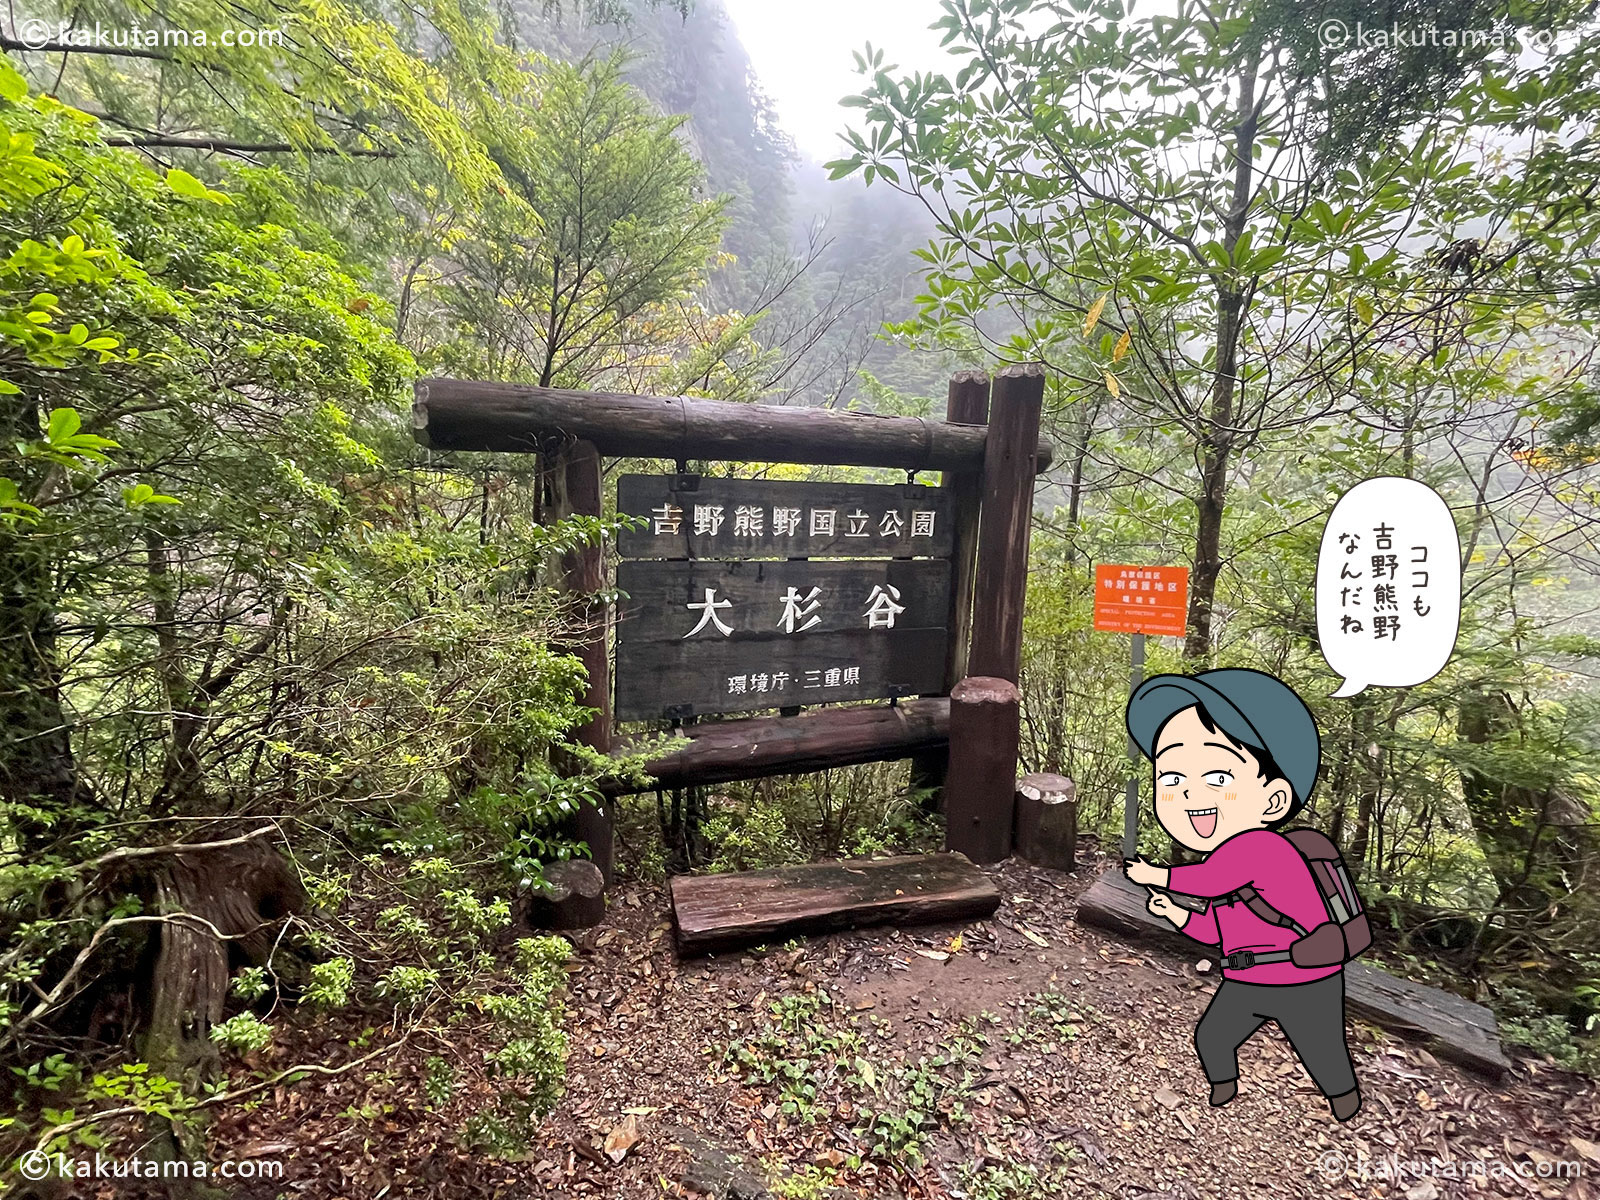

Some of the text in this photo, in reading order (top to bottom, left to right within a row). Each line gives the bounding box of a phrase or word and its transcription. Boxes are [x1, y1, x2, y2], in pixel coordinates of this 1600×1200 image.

[651, 502, 936, 538] 吉野熊野国立公園
[682, 584, 906, 639] 大杉谷
